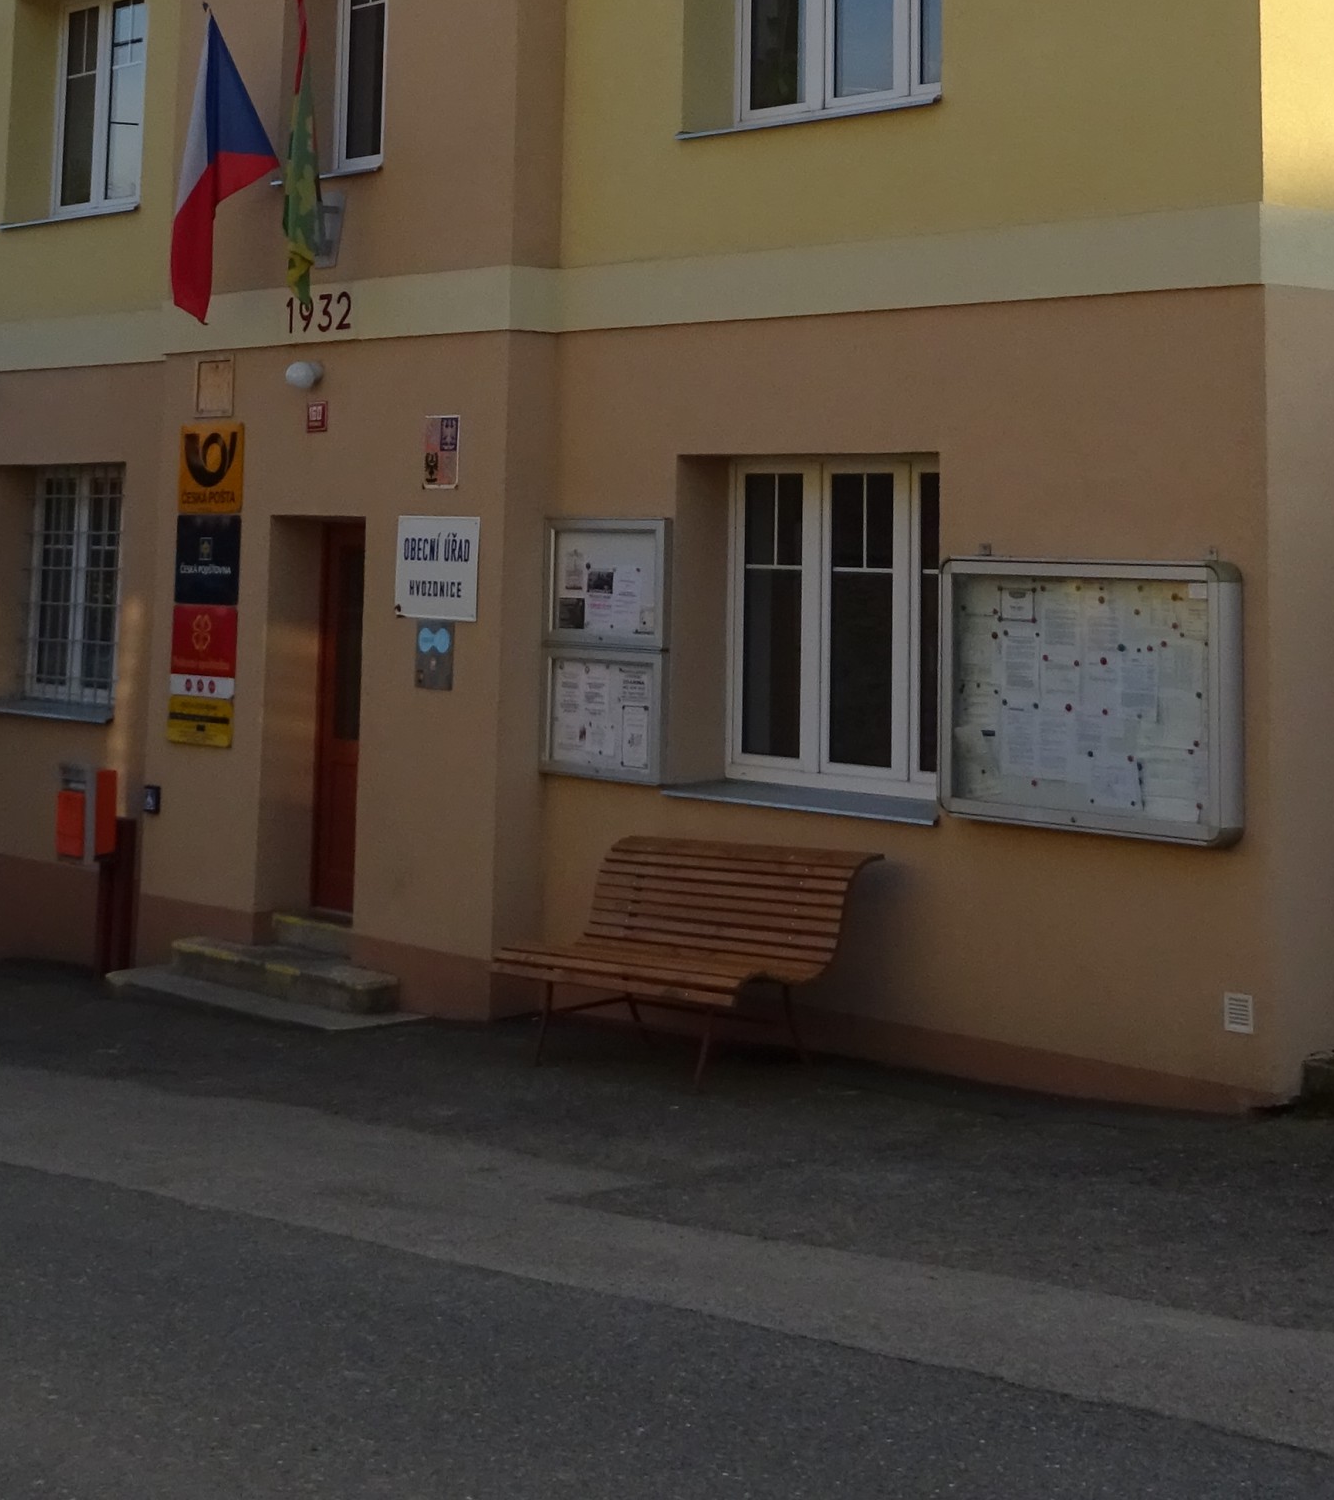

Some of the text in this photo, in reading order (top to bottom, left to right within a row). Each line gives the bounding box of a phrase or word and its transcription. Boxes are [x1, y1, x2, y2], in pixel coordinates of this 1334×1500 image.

[286, 291, 351, 334] 1932
[208, 488, 236, 504] POŠTA
[404, 532, 471, 562] OBECNÍ ÚŘAD
[409, 580, 462, 598] HVOZDNICE
